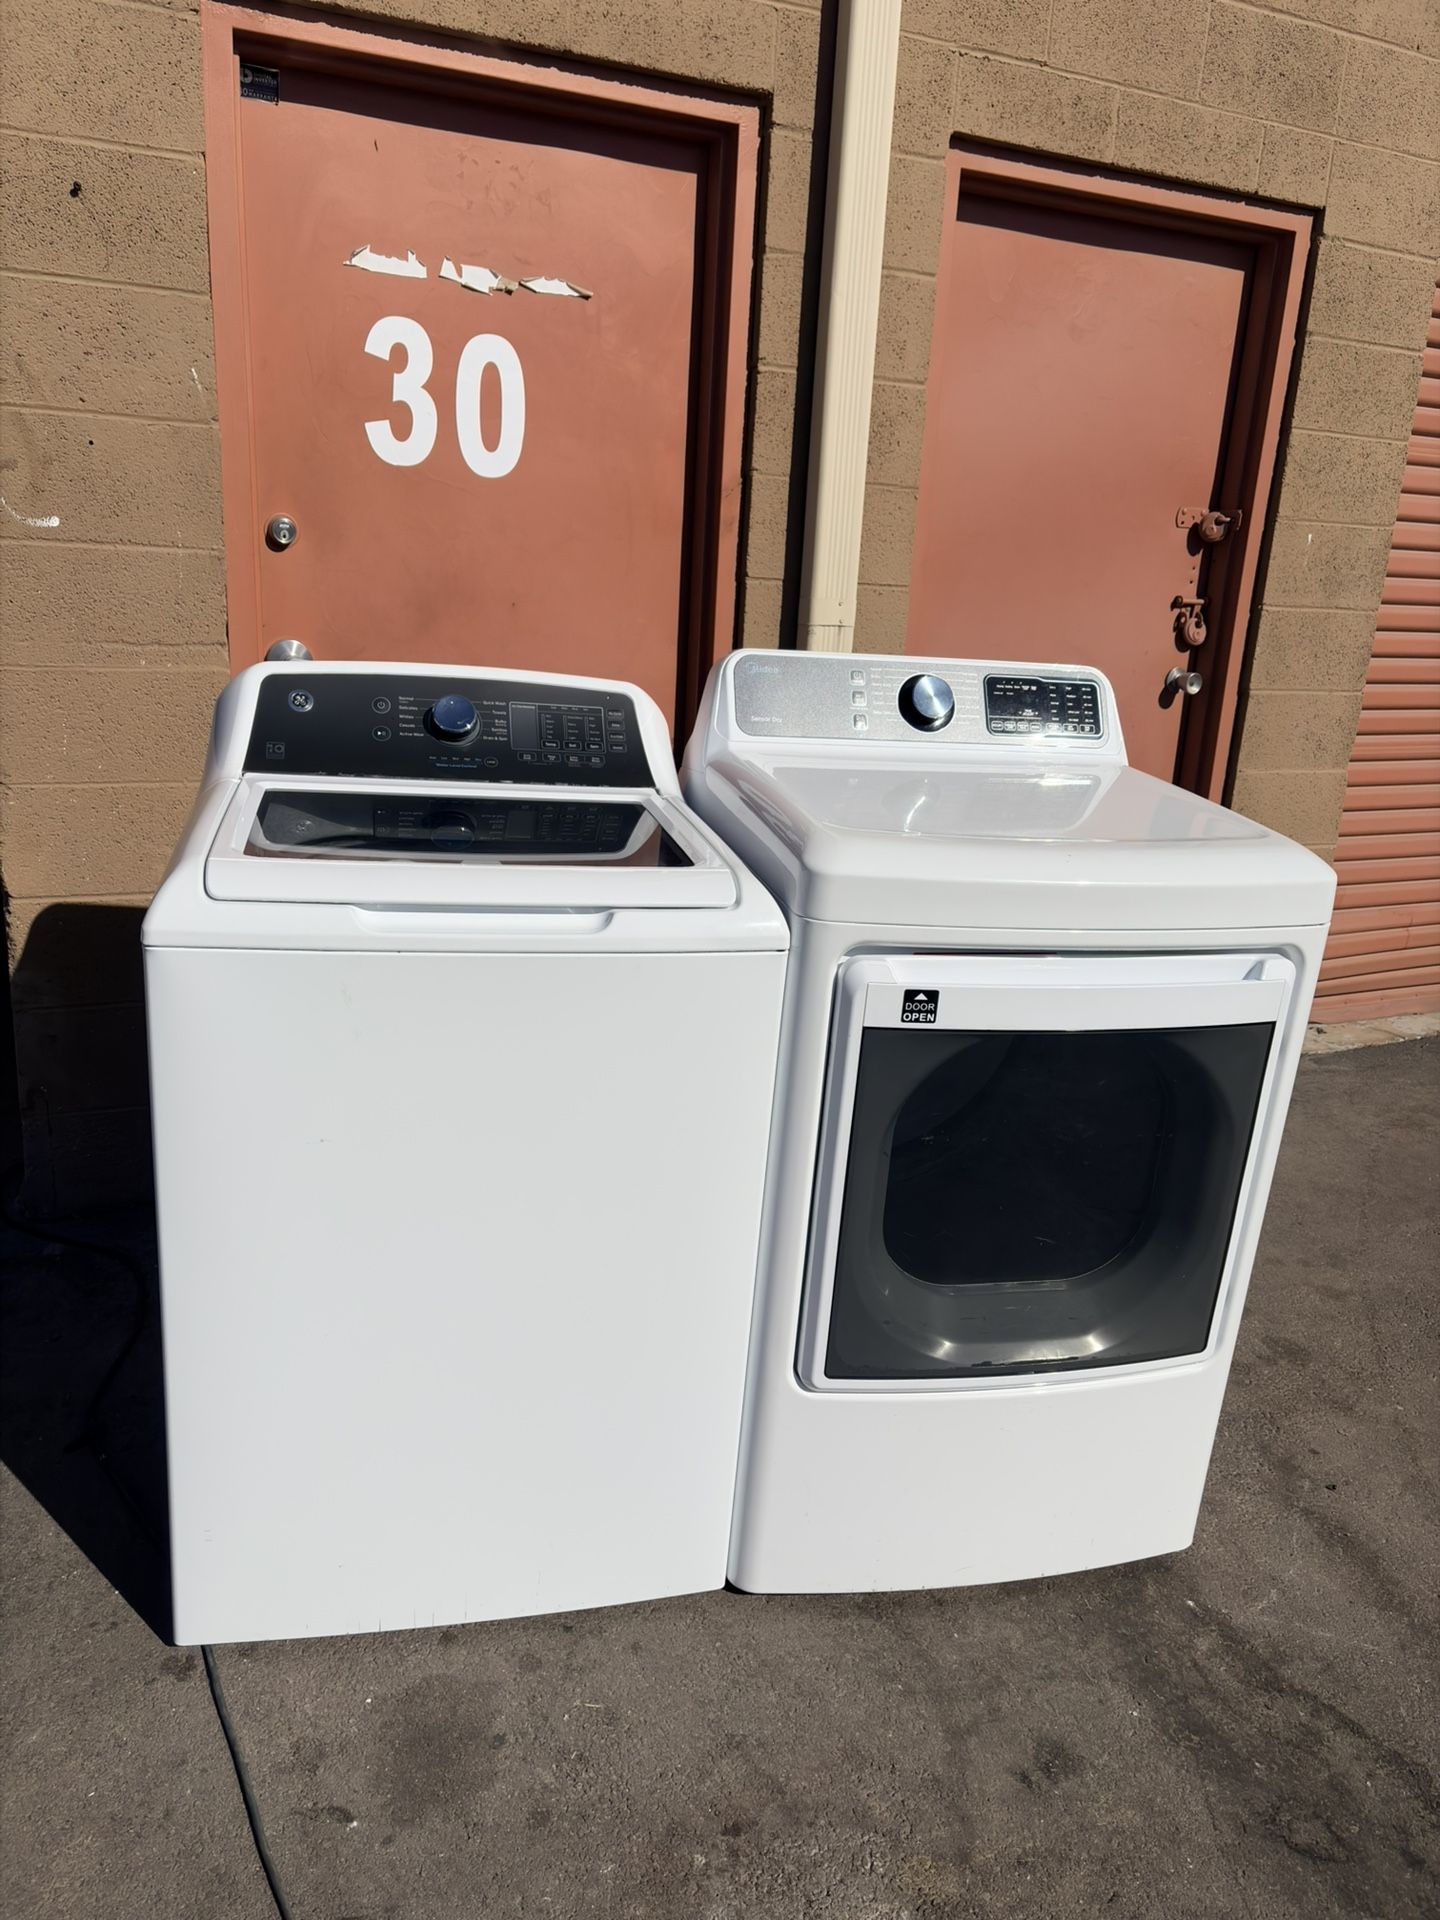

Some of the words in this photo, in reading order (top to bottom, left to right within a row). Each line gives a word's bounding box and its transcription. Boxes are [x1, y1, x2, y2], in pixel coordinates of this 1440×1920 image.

[364, 315, 526, 478] 30
[905, 1003, 935, 1011] DOOR
[903, 1012, 935, 1022] OPEN
